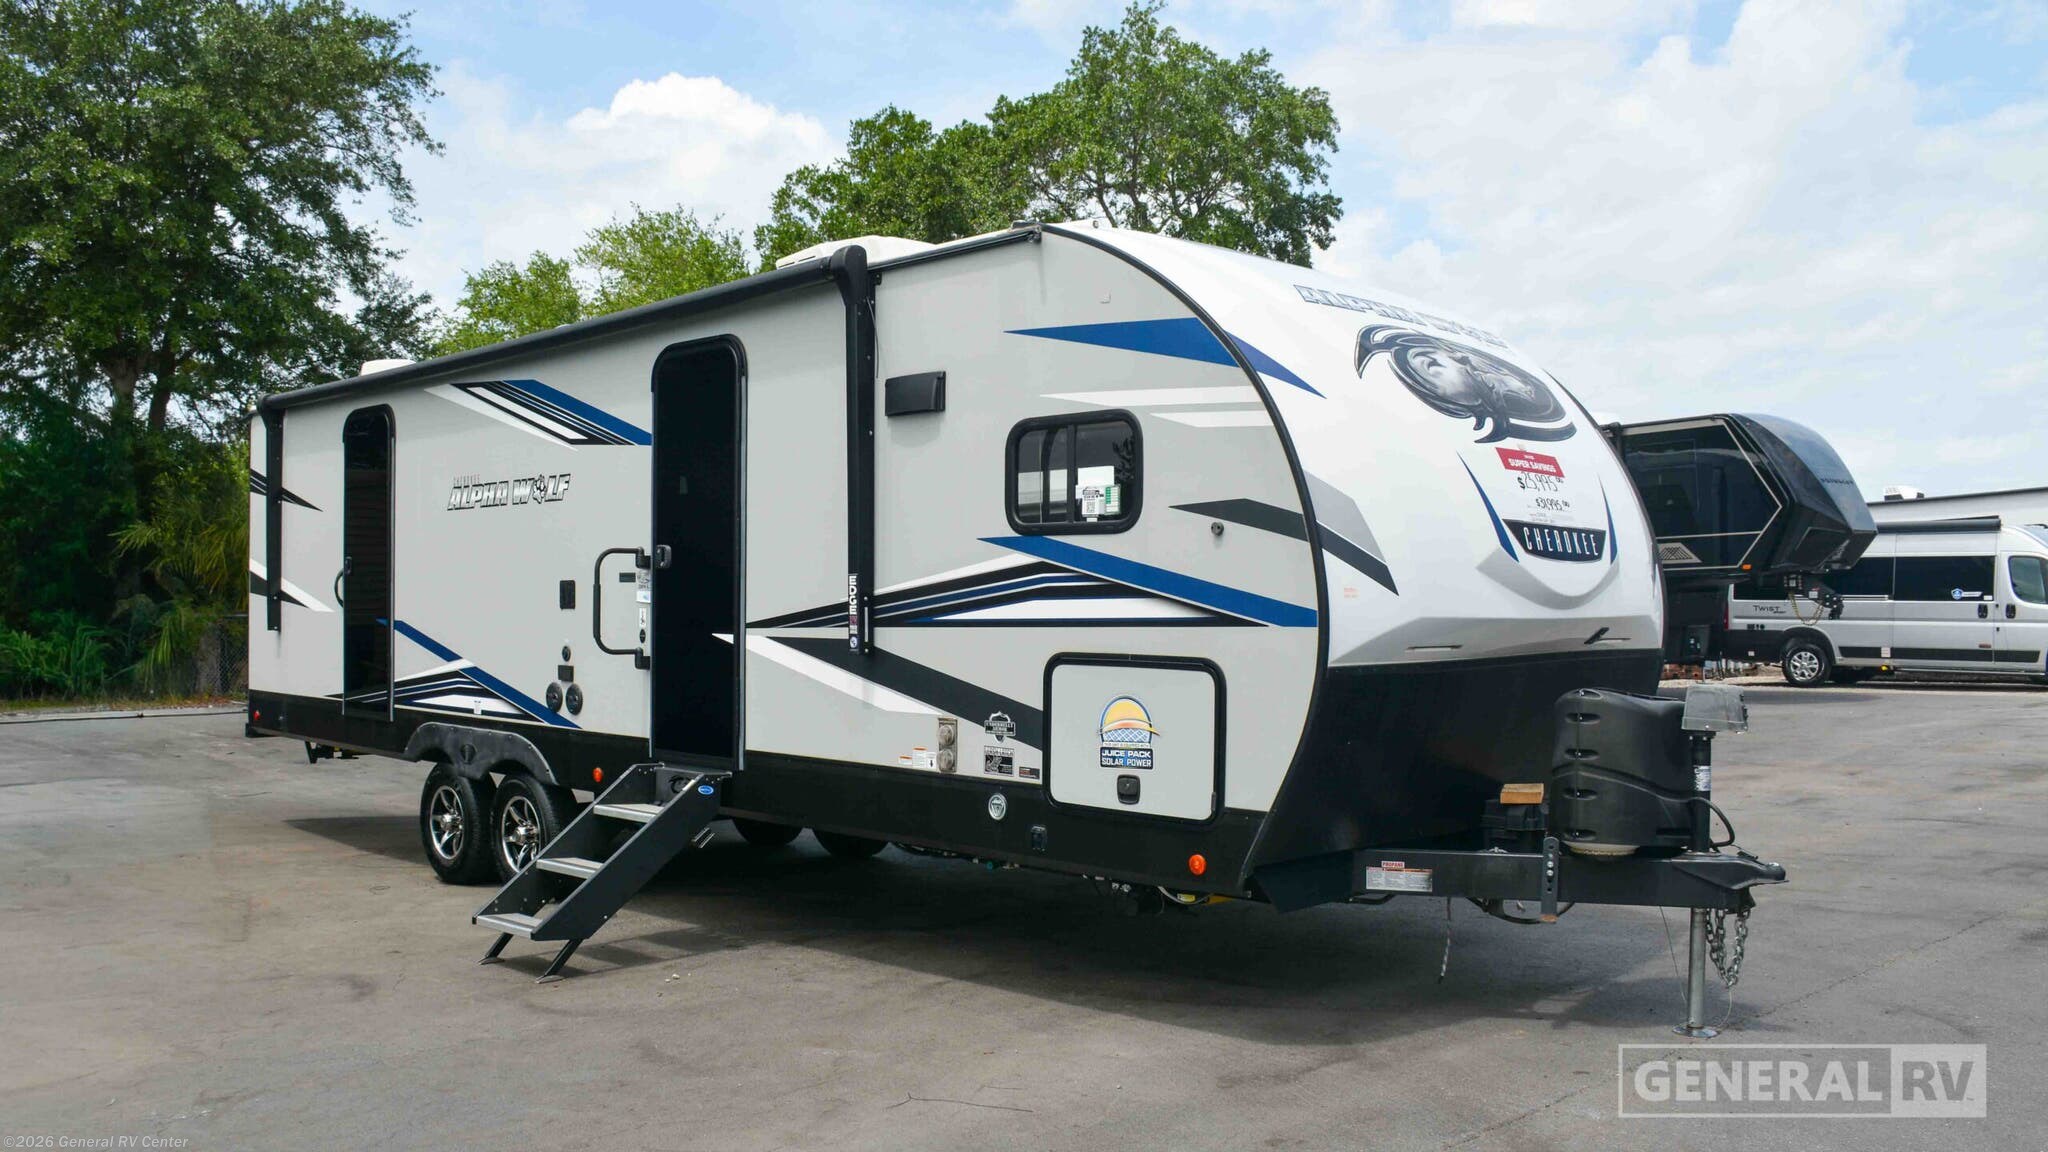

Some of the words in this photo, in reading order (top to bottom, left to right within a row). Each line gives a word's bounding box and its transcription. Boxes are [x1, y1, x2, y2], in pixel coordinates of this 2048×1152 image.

[447, 481, 509, 511] ALPHA
[1523, 526, 1599, 556] CHEROKEE
[848, 575, 858, 615] EDGE
[1101, 749, 1126, 757] JUICE
[1127, 750, 1151, 759] PACK
[1101, 757, 1124, 766] SOLAR
[1126, 758, 1152, 767] POWER
